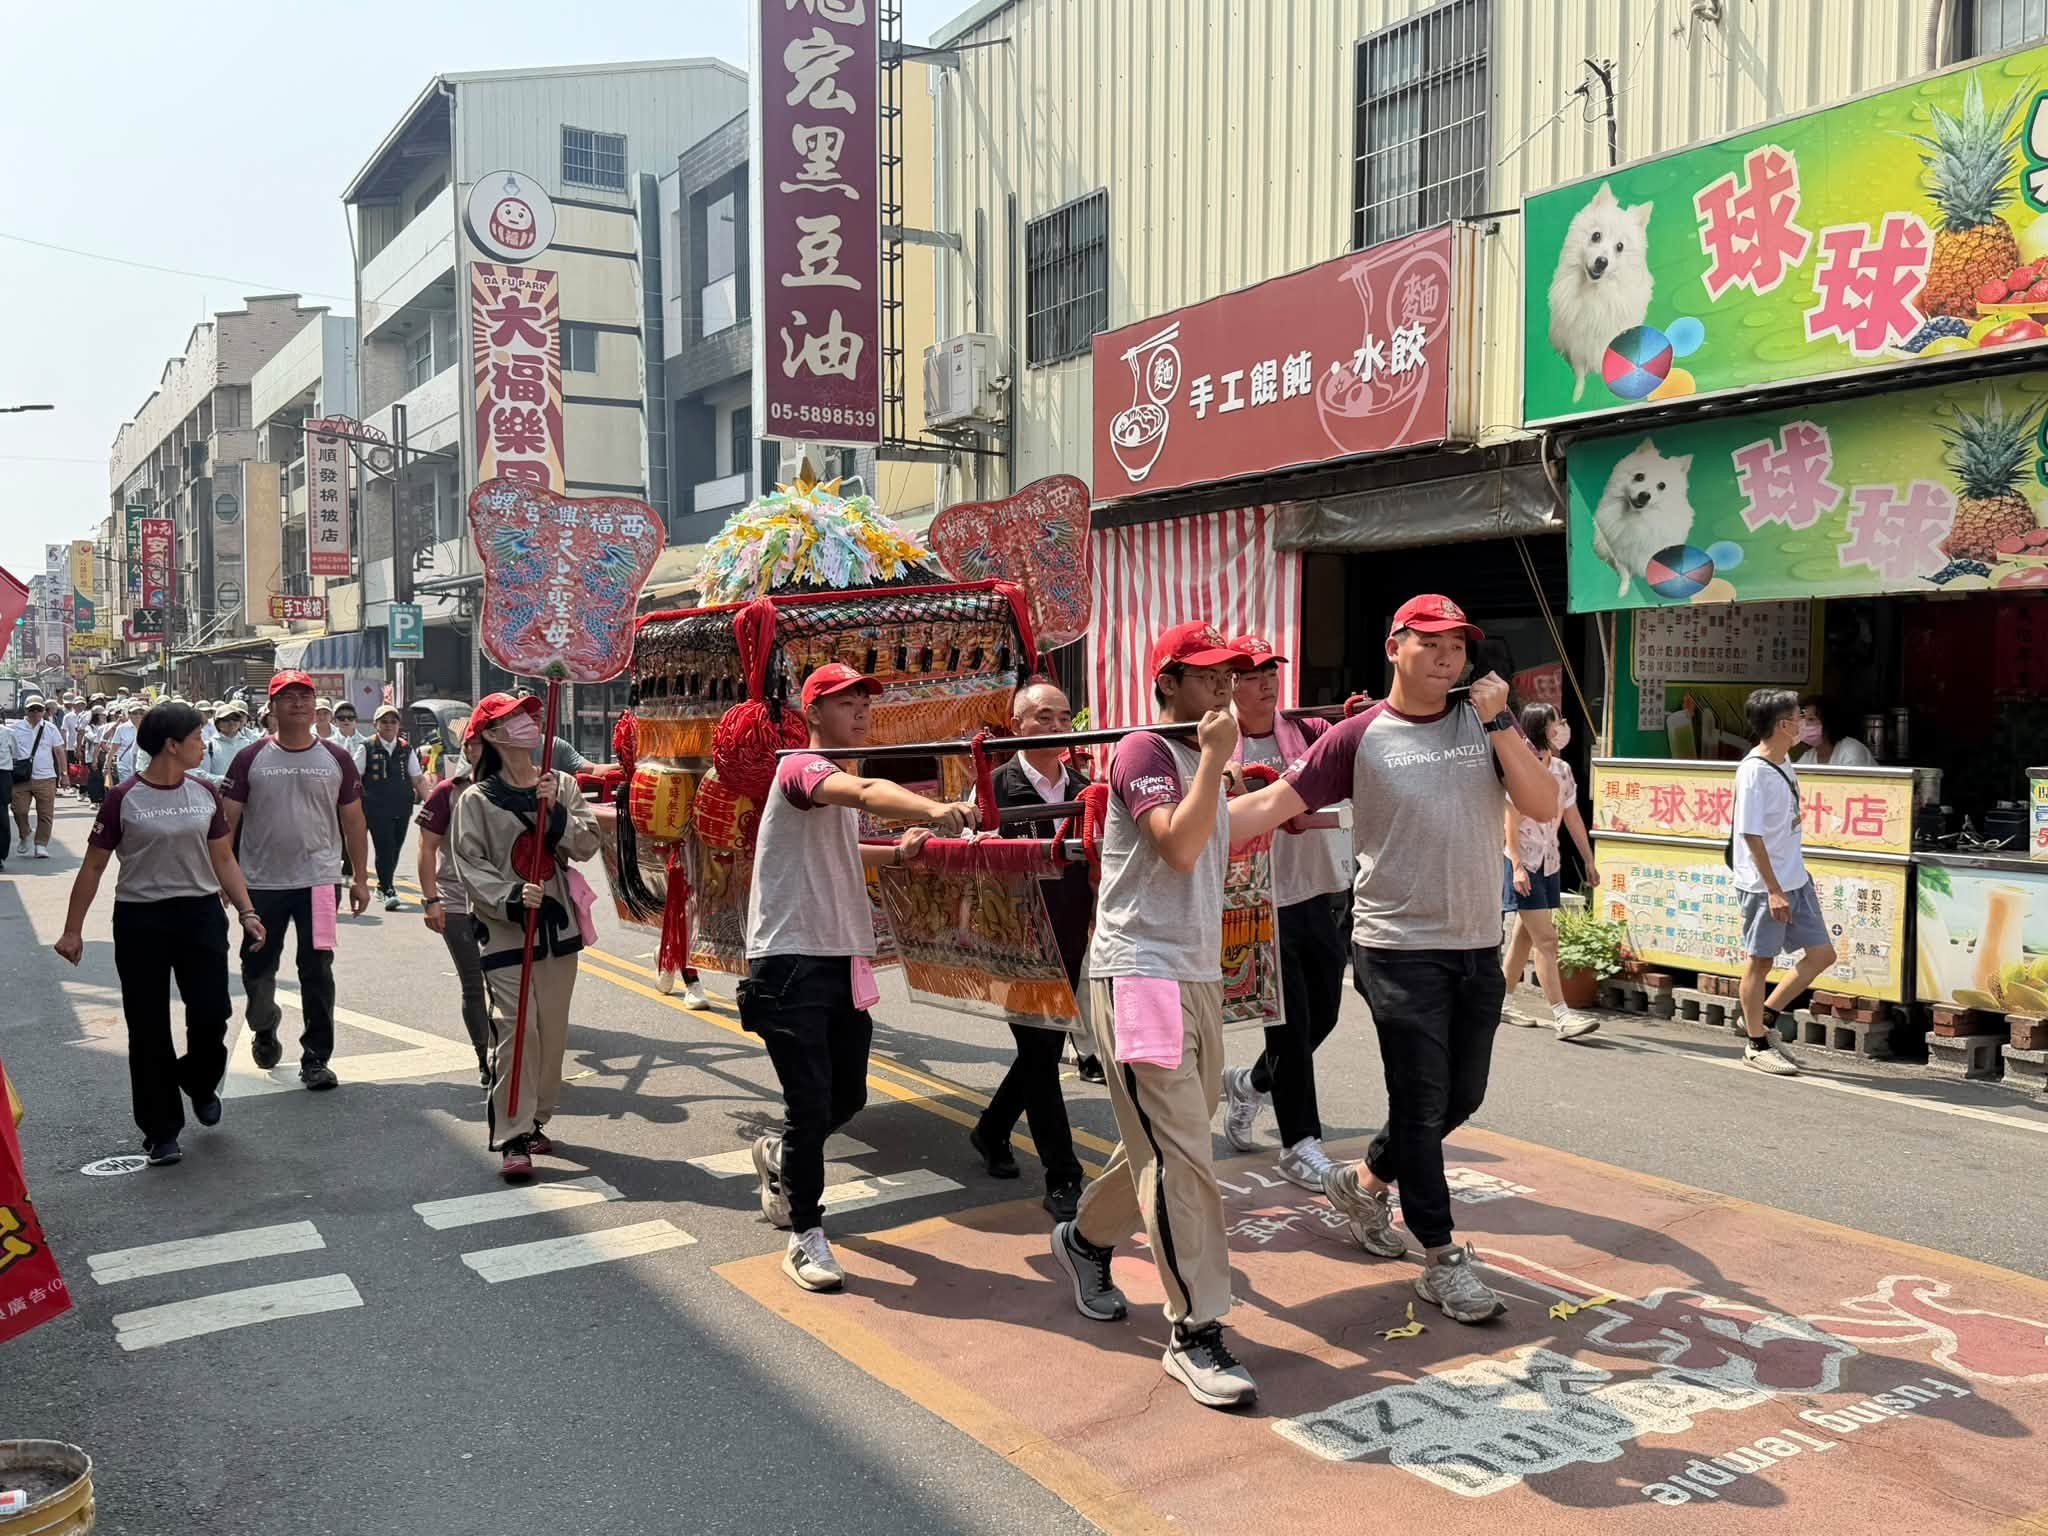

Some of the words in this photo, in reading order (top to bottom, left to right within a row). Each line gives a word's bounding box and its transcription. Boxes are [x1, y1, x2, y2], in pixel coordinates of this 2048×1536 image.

[1695, 146, 1935, 354] 球球
[483, 276, 499, 285] DA
[501, 278, 515, 287] FU
[518, 279, 547, 291] PARK
[1153, 357, 1174, 392] 麵
[771, 402, 875, 427] 05-5898539
[318, 449, 339, 542] 順發棉被店
[1733, 421, 1955, 580] 球球
[395, 613, 415, 640] P
[1444, 744, 1486, 760] MATZU
[1227, 861, 1250, 886] 天
[1798, 1377, 1971, 1434] Fusing
[1641, 1428, 1840, 1506] Temple
